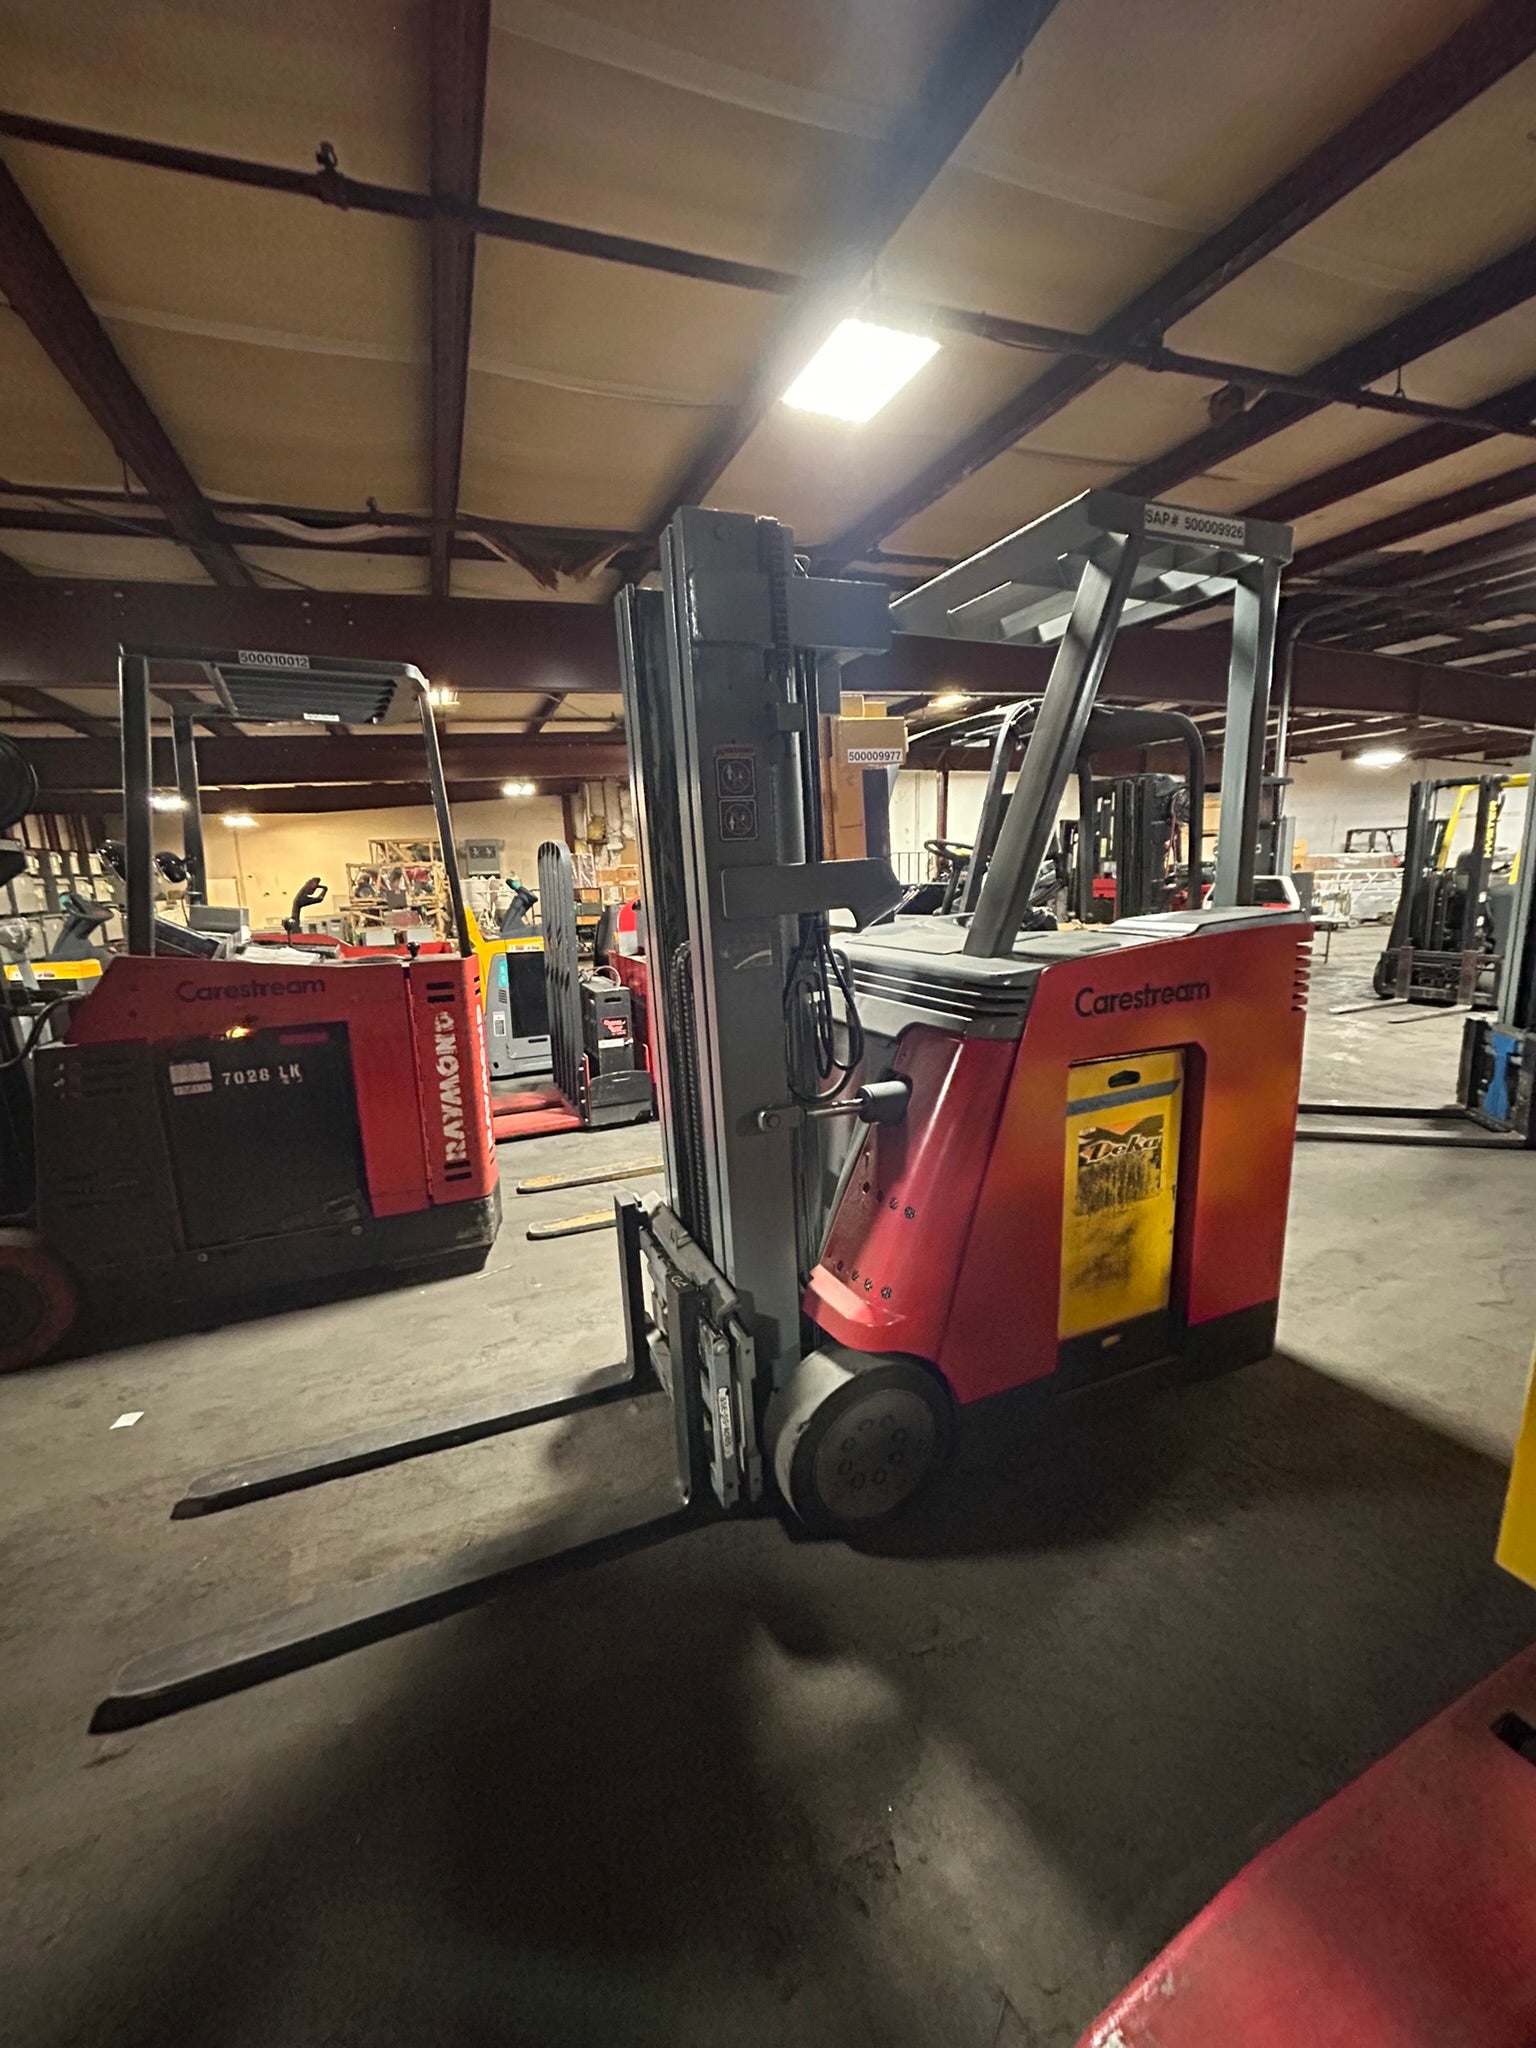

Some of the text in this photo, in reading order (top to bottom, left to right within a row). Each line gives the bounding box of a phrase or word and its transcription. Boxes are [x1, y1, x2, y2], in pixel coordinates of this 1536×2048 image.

[1145, 508, 1244, 539] SAP# 500009926
[240, 652, 308, 667] 500010012
[848, 751, 901, 761] 500009977
[176, 979, 326, 1003] Carestream
[1075, 982, 1210, 1018] Carestream
[435, 1012, 467, 1161] RAYMOND
[1081, 1132, 1163, 1164] Deka
